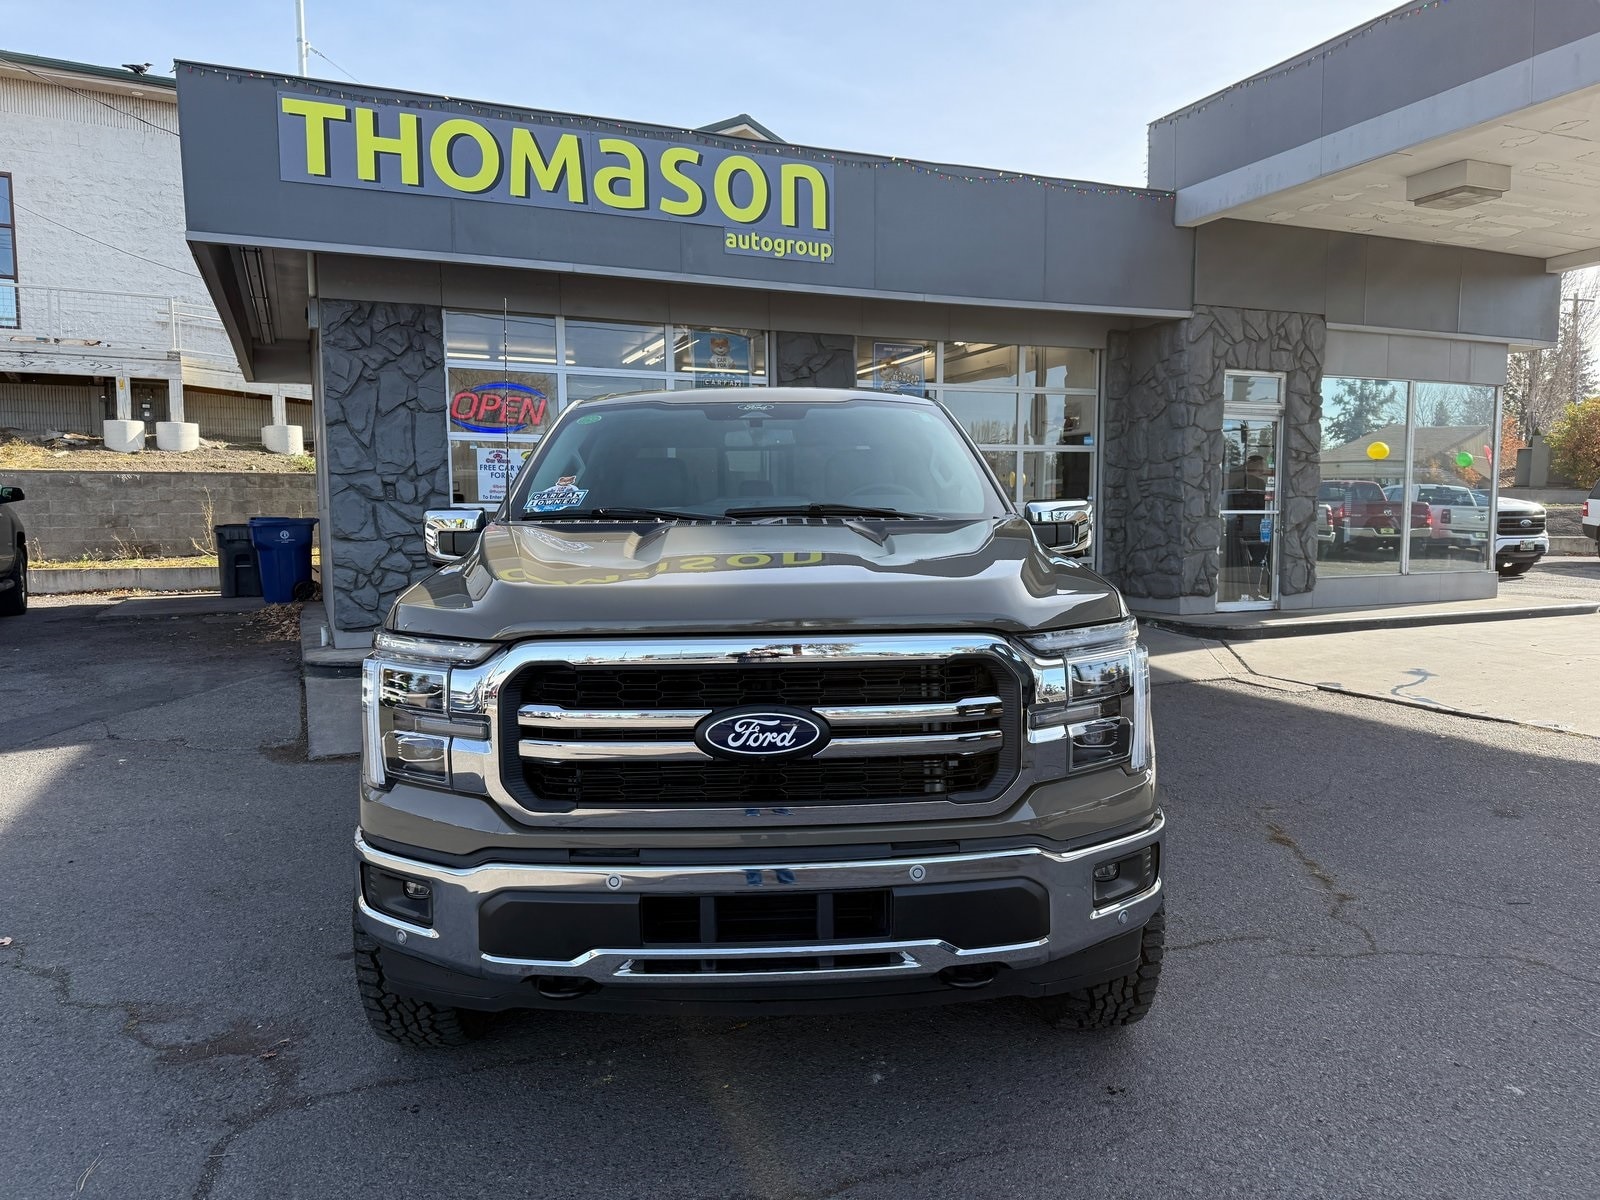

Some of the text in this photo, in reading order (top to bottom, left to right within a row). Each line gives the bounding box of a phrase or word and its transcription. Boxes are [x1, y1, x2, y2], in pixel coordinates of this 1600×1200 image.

[725, 232, 833, 261] autogroup
[703, 378, 743, 387] CARFAX
[450, 391, 547, 426] OPEN
[533, 491, 583, 500] CARFAX
[727, 718, 798, 747] Ford
